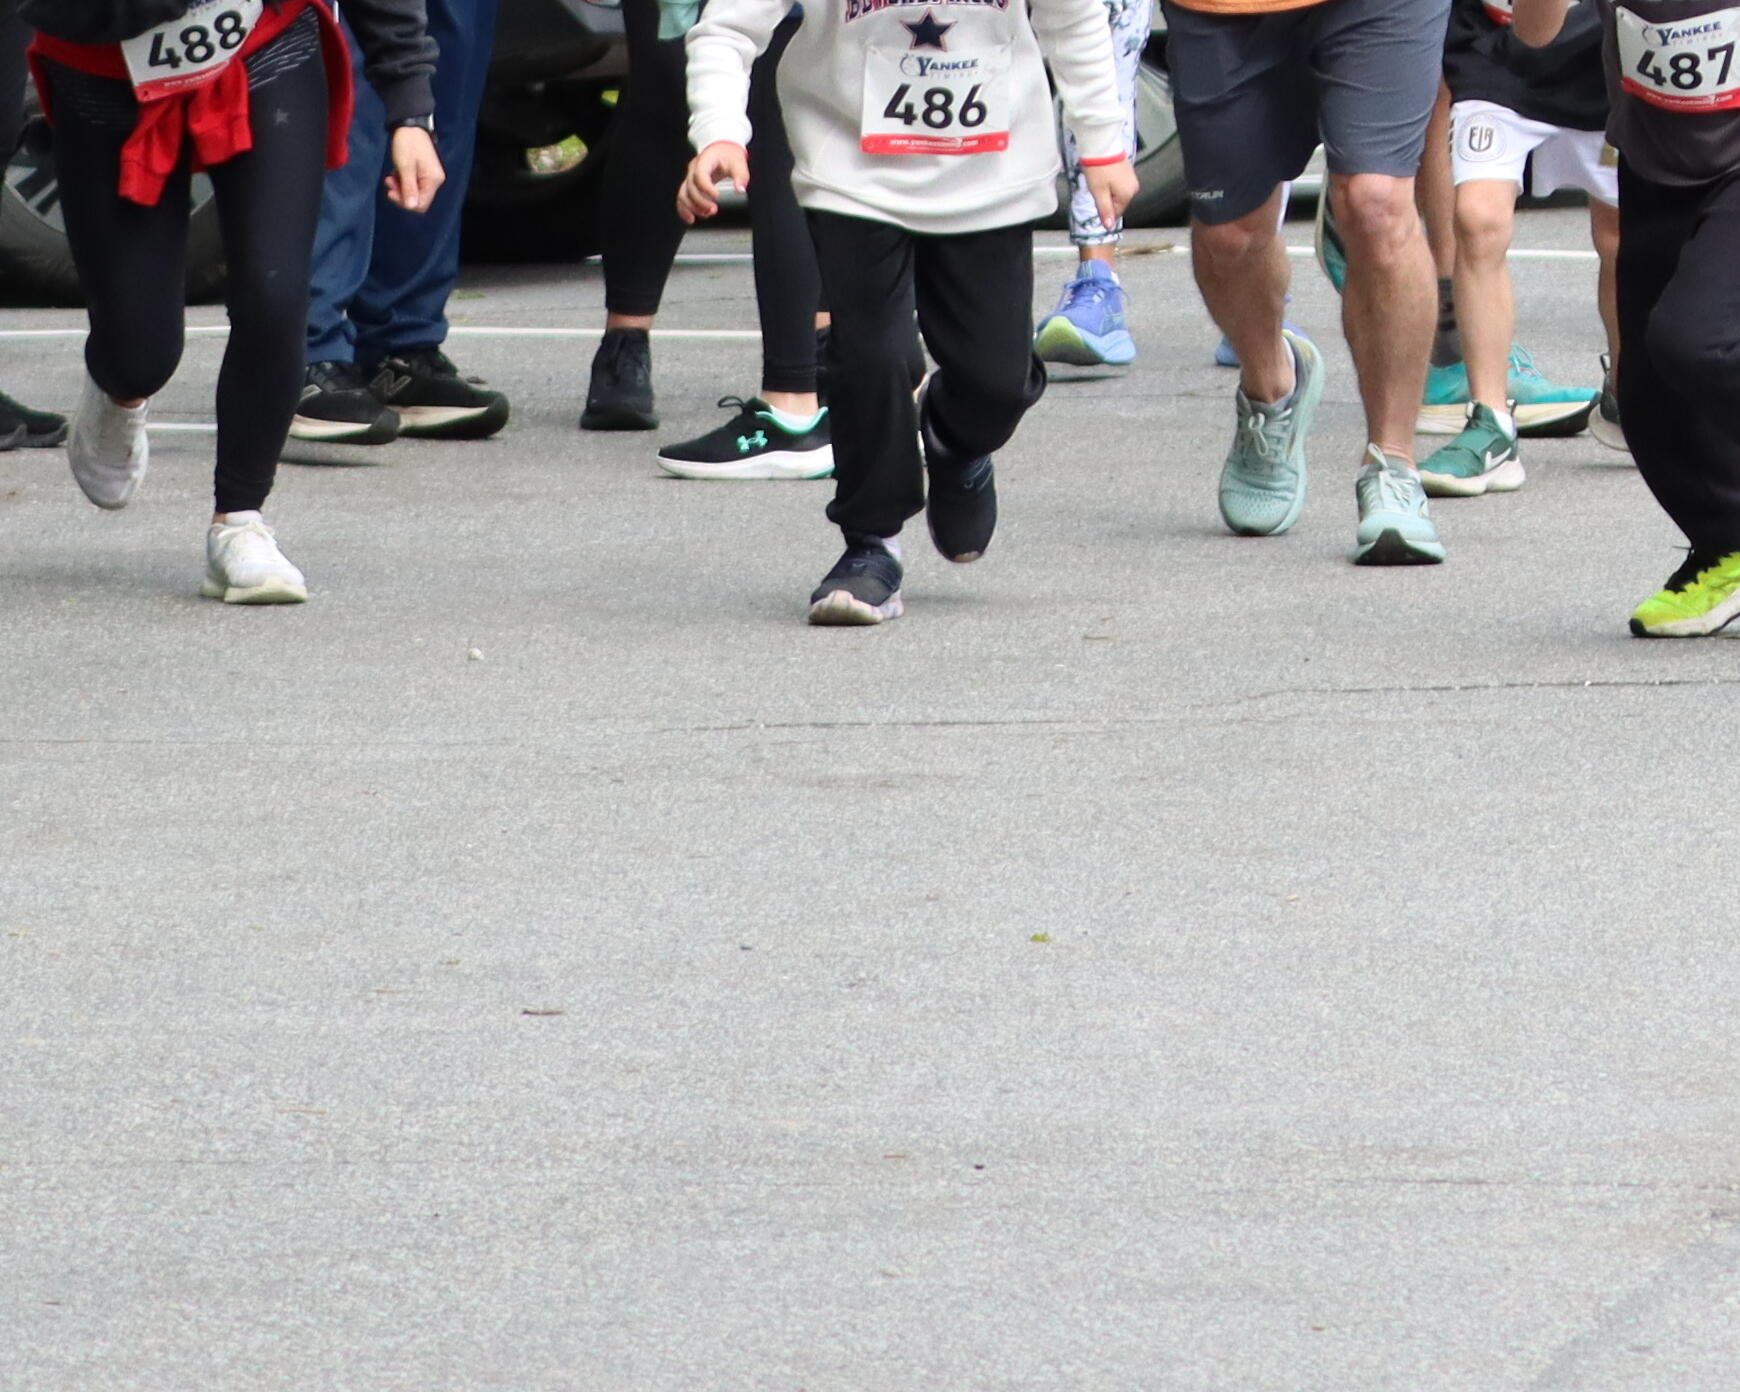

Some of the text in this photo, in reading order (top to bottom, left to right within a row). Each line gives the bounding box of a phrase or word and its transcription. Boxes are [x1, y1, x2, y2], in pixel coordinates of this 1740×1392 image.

[147, 9, 248, 72] 488
[1656, 20, 1722, 45] YANKEE
[917, 55, 979, 78] YANKEE
[1636, 41, 1738, 91] 487
[883, 83, 987, 129] 486
